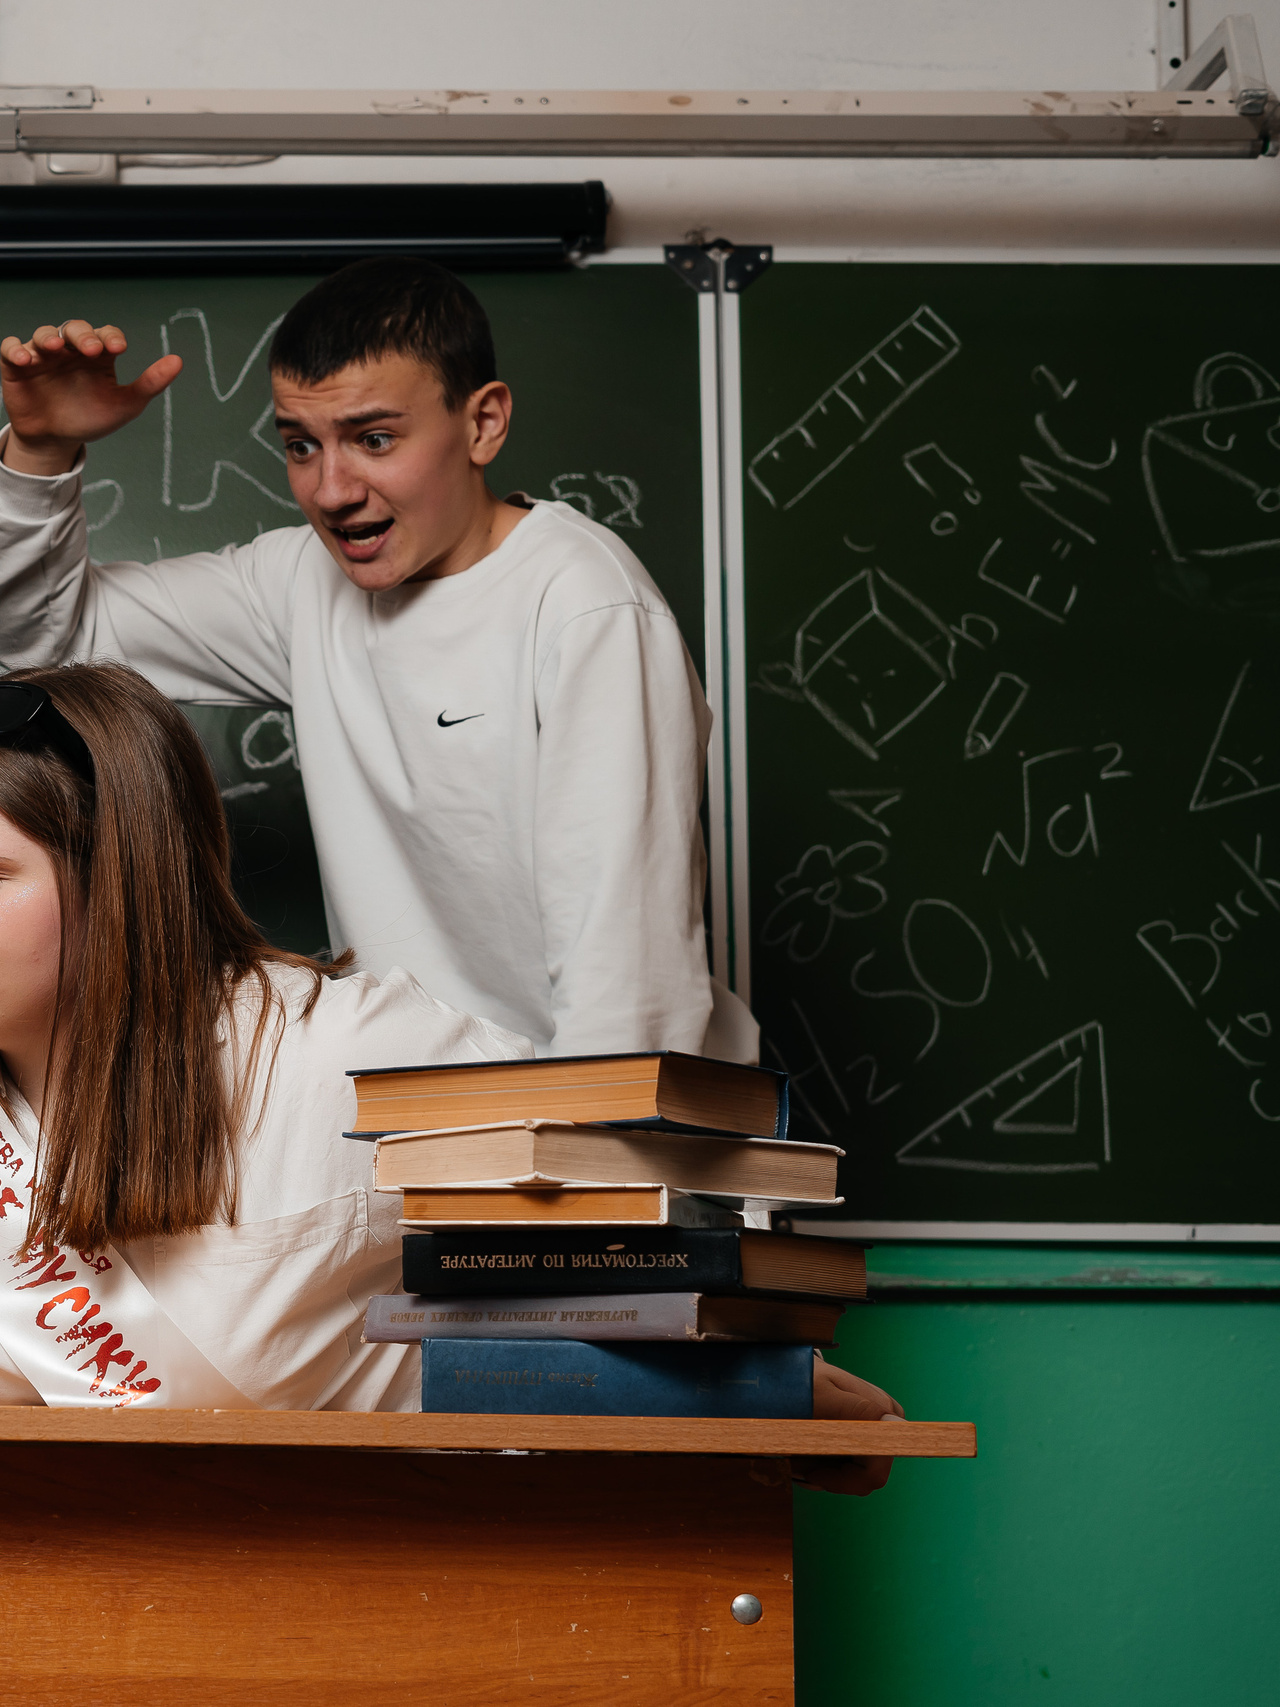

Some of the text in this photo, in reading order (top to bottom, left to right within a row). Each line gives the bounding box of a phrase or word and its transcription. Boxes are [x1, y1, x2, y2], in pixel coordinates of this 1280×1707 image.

[440, 1253, 689, 1269] ХРЕСТОМАТИЯ ПО ЛИТЕРАТУРЕ
[487, 1310, 557, 1322] ЛИТЕРАТУРА
[560, 1308, 639, 1322] ЗАРУБЕЖНАЯ
